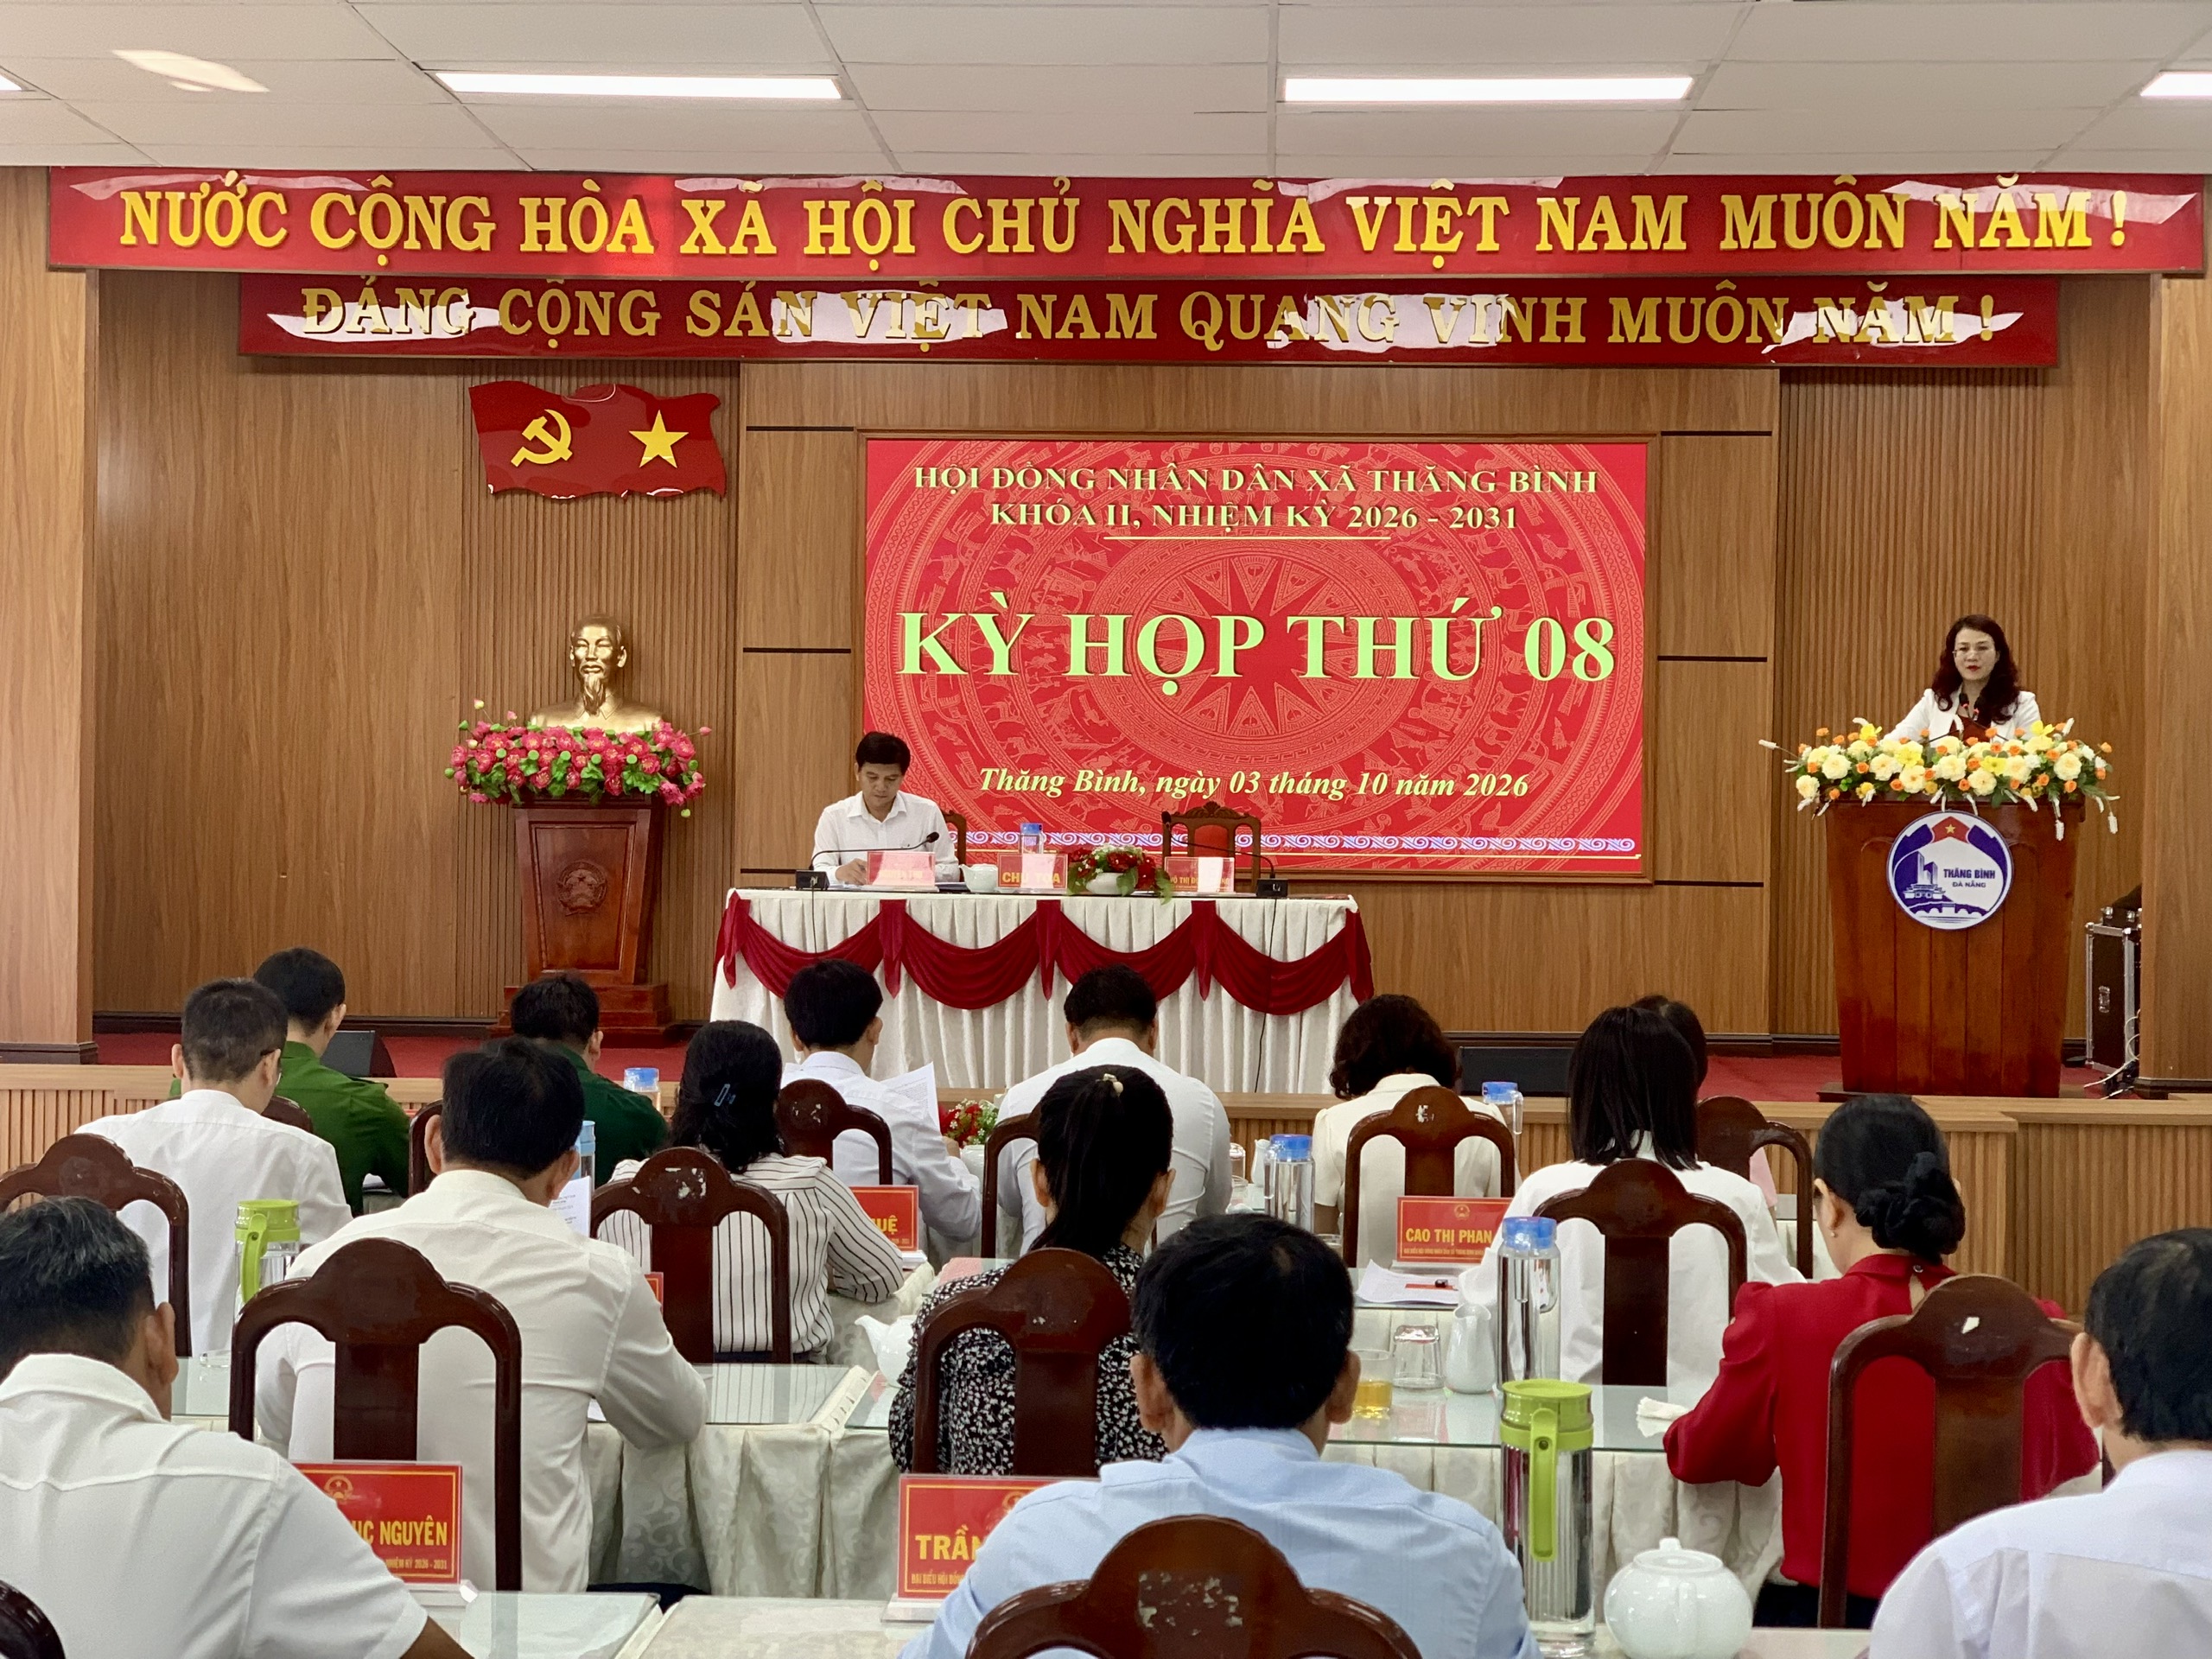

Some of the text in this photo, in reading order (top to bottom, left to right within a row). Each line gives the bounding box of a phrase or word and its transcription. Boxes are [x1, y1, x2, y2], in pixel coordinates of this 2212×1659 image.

[119, 169, 2126, 271] NƯỚC CỘNG HÒA XÃ HỘI CHỦ NGHĨA VIỆT NAM MUÔN NĂM !
[301, 275, 476, 335] ĐẢNG
[499, 278, 663, 349] CỘNG
[840, 280, 993, 353] VIỆT
[1015, 294, 1158, 339] NAM
[1179, 291, 1401, 351] QUANG
[1423, 295, 1588, 344] VINH
[1608, 279, 1790, 344] MUÔN
[1812, 281, 1960, 344] NĂM
[1980, 295, 1995, 341] !
[914, 461, 1598, 495] HỘI ĐỒNG NHÂN DÂN XÃ THĂNG BÌNH
[990, 498, 1096, 526] KHÓA
[1107, 505, 1141, 530] II,
[1152, 501, 1281, 533] NHIỆM
[1287, 499, 1338, 528] KỲ
[1348, 505, 1418, 530] 2026
[1448, 505, 1517, 530] 2031
[896, 591, 1615, 697] KỲ HỌP THỨ 08
[979, 767, 1530, 801] Thăng Bình, ngày 03 tháng 10 năm 2026
[1943, 868, 1995, 879] THĂNG BÌNH
[871, 1215, 898, 1235] UỆ
[1405, 1228, 1492, 1246] CAO THỊ PHAN
[380, 1515, 448, 1547] NGUYÊN
